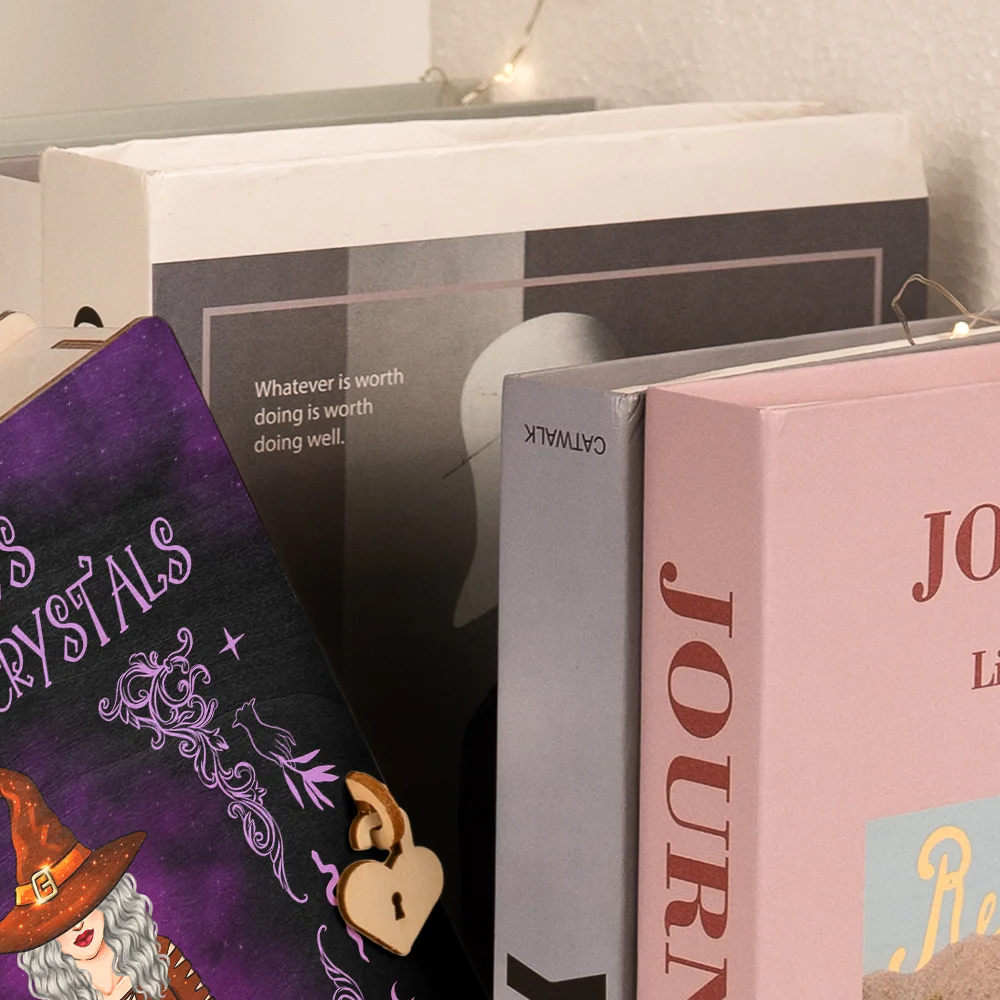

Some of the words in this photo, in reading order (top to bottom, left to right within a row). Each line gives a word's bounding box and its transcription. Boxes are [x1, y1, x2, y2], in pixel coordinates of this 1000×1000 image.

[254, 377, 334, 398] Whatever
[338, 374, 350, 391] is
[355, 368, 404, 389] worth
[254, 407, 303, 427] doing
[307, 403, 320, 421] is
[324, 398, 373, 419] worth
[254, 434, 303, 454] doing
[307, 428, 345, 448] well.
[524, 424, 606, 455] CATWALK
